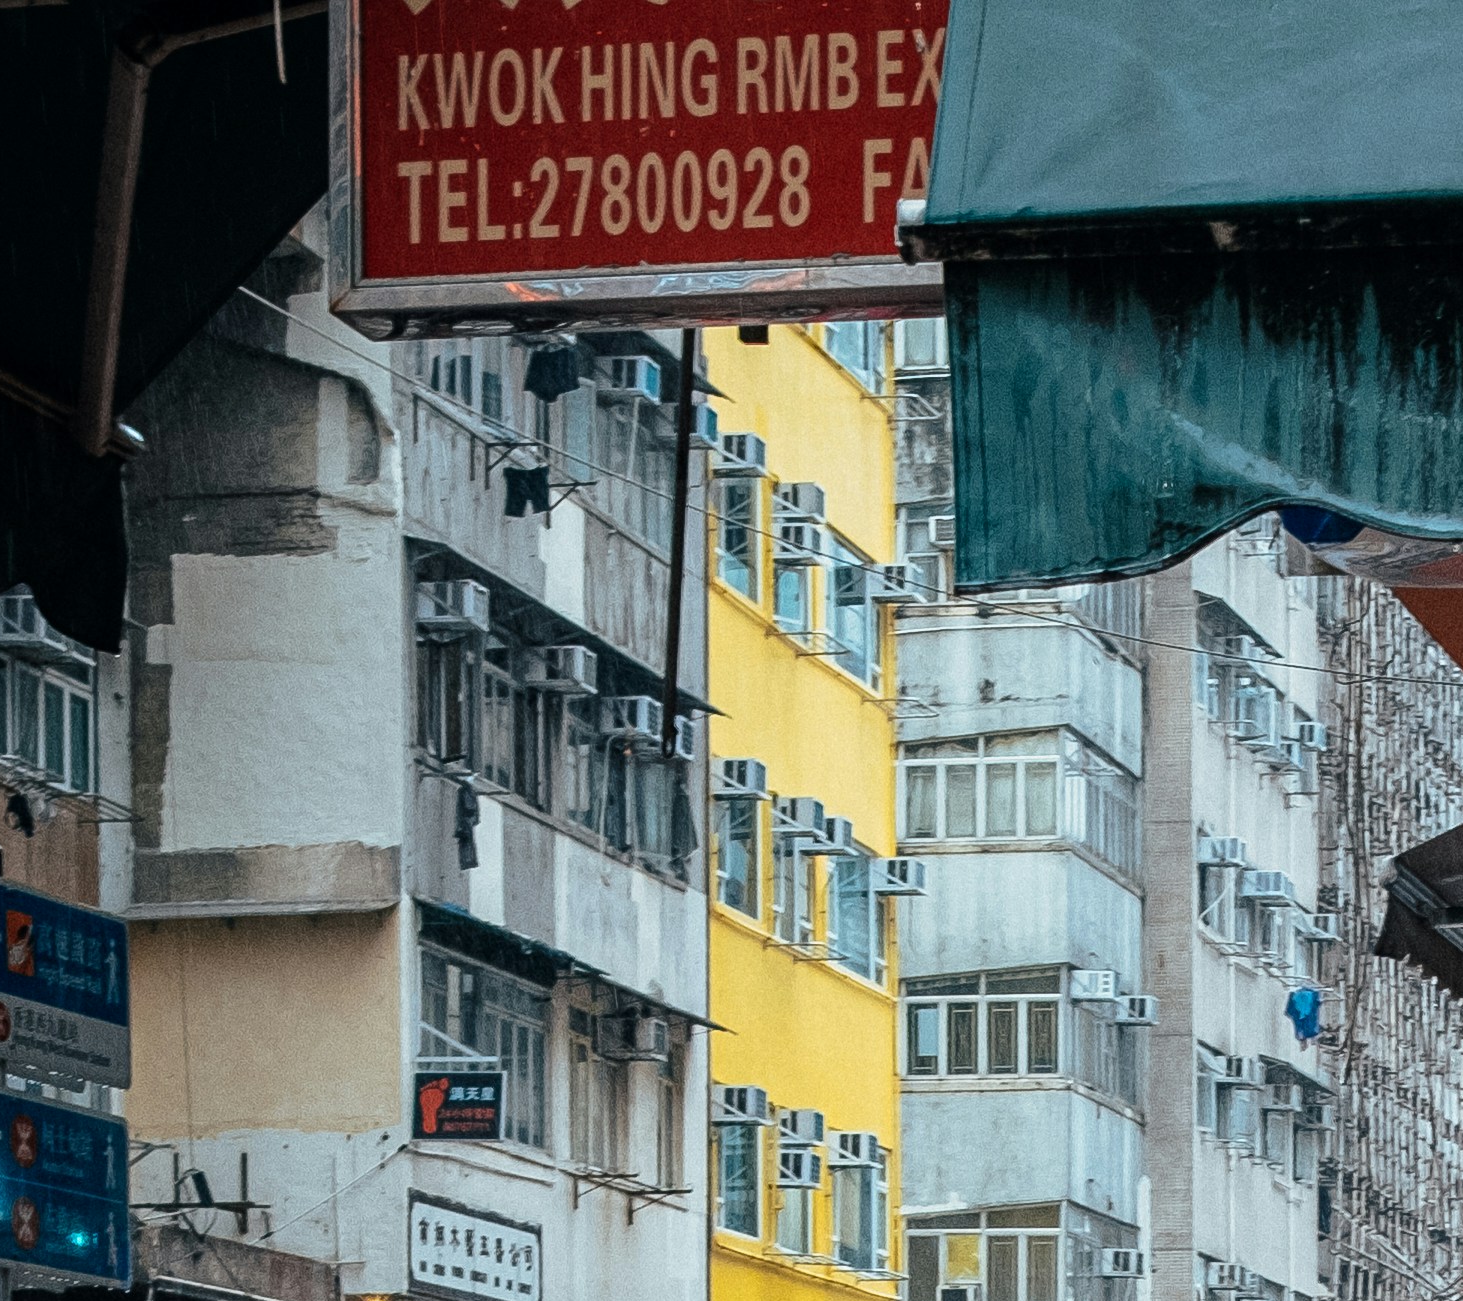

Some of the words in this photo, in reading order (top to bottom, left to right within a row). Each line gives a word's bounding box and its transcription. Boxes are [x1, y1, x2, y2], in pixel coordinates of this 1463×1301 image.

[398, 45, 566, 131] KWOK
[581, 38, 720, 122] HING
[736, 32, 860, 115] RMB
[397, 145, 811, 245] TEL:27800928
